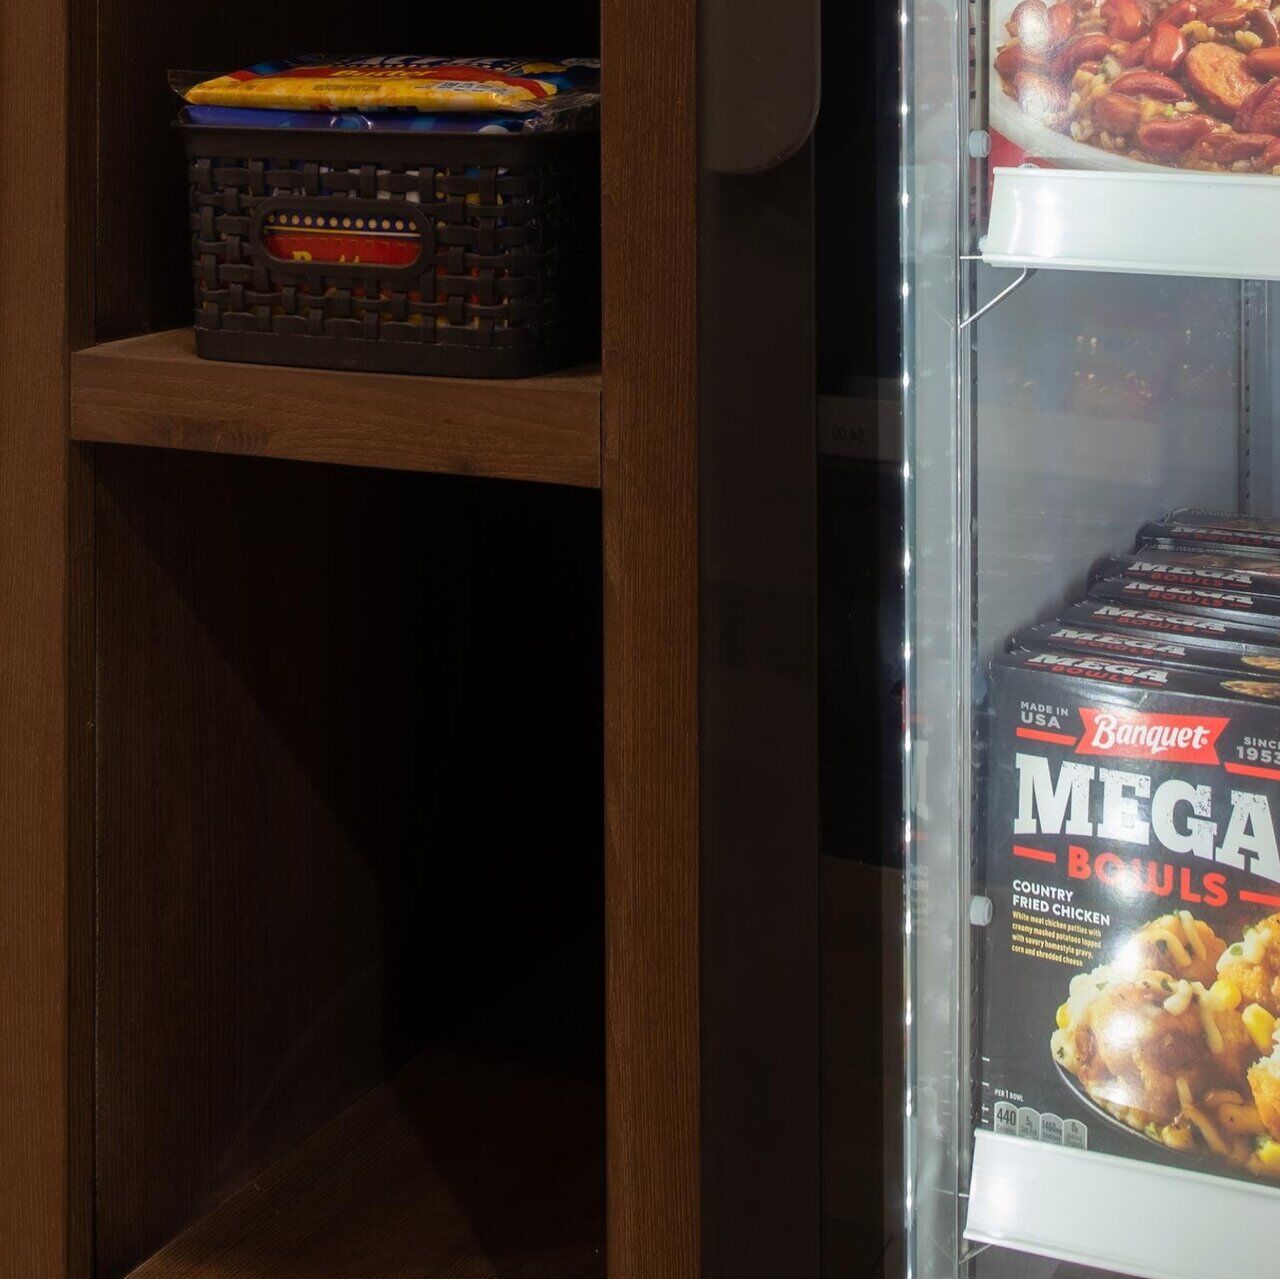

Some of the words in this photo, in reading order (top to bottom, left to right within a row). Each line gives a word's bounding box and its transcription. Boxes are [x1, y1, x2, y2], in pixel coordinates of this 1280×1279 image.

[1020, 700, 1055, 715] MADE
[1056, 705, 1069, 716] IN
[1021, 713, 1062, 730] USA
[1091, 713, 1210, 755] Banquet
[1068, 845, 1229, 907] BOWLS
[1012, 879, 1074, 903] COUNTRY
[1012, 894, 1049, 913] FRIED
[1052, 903, 1110, 926] CHICKEN
[997, 1107, 1017, 1126] 440
